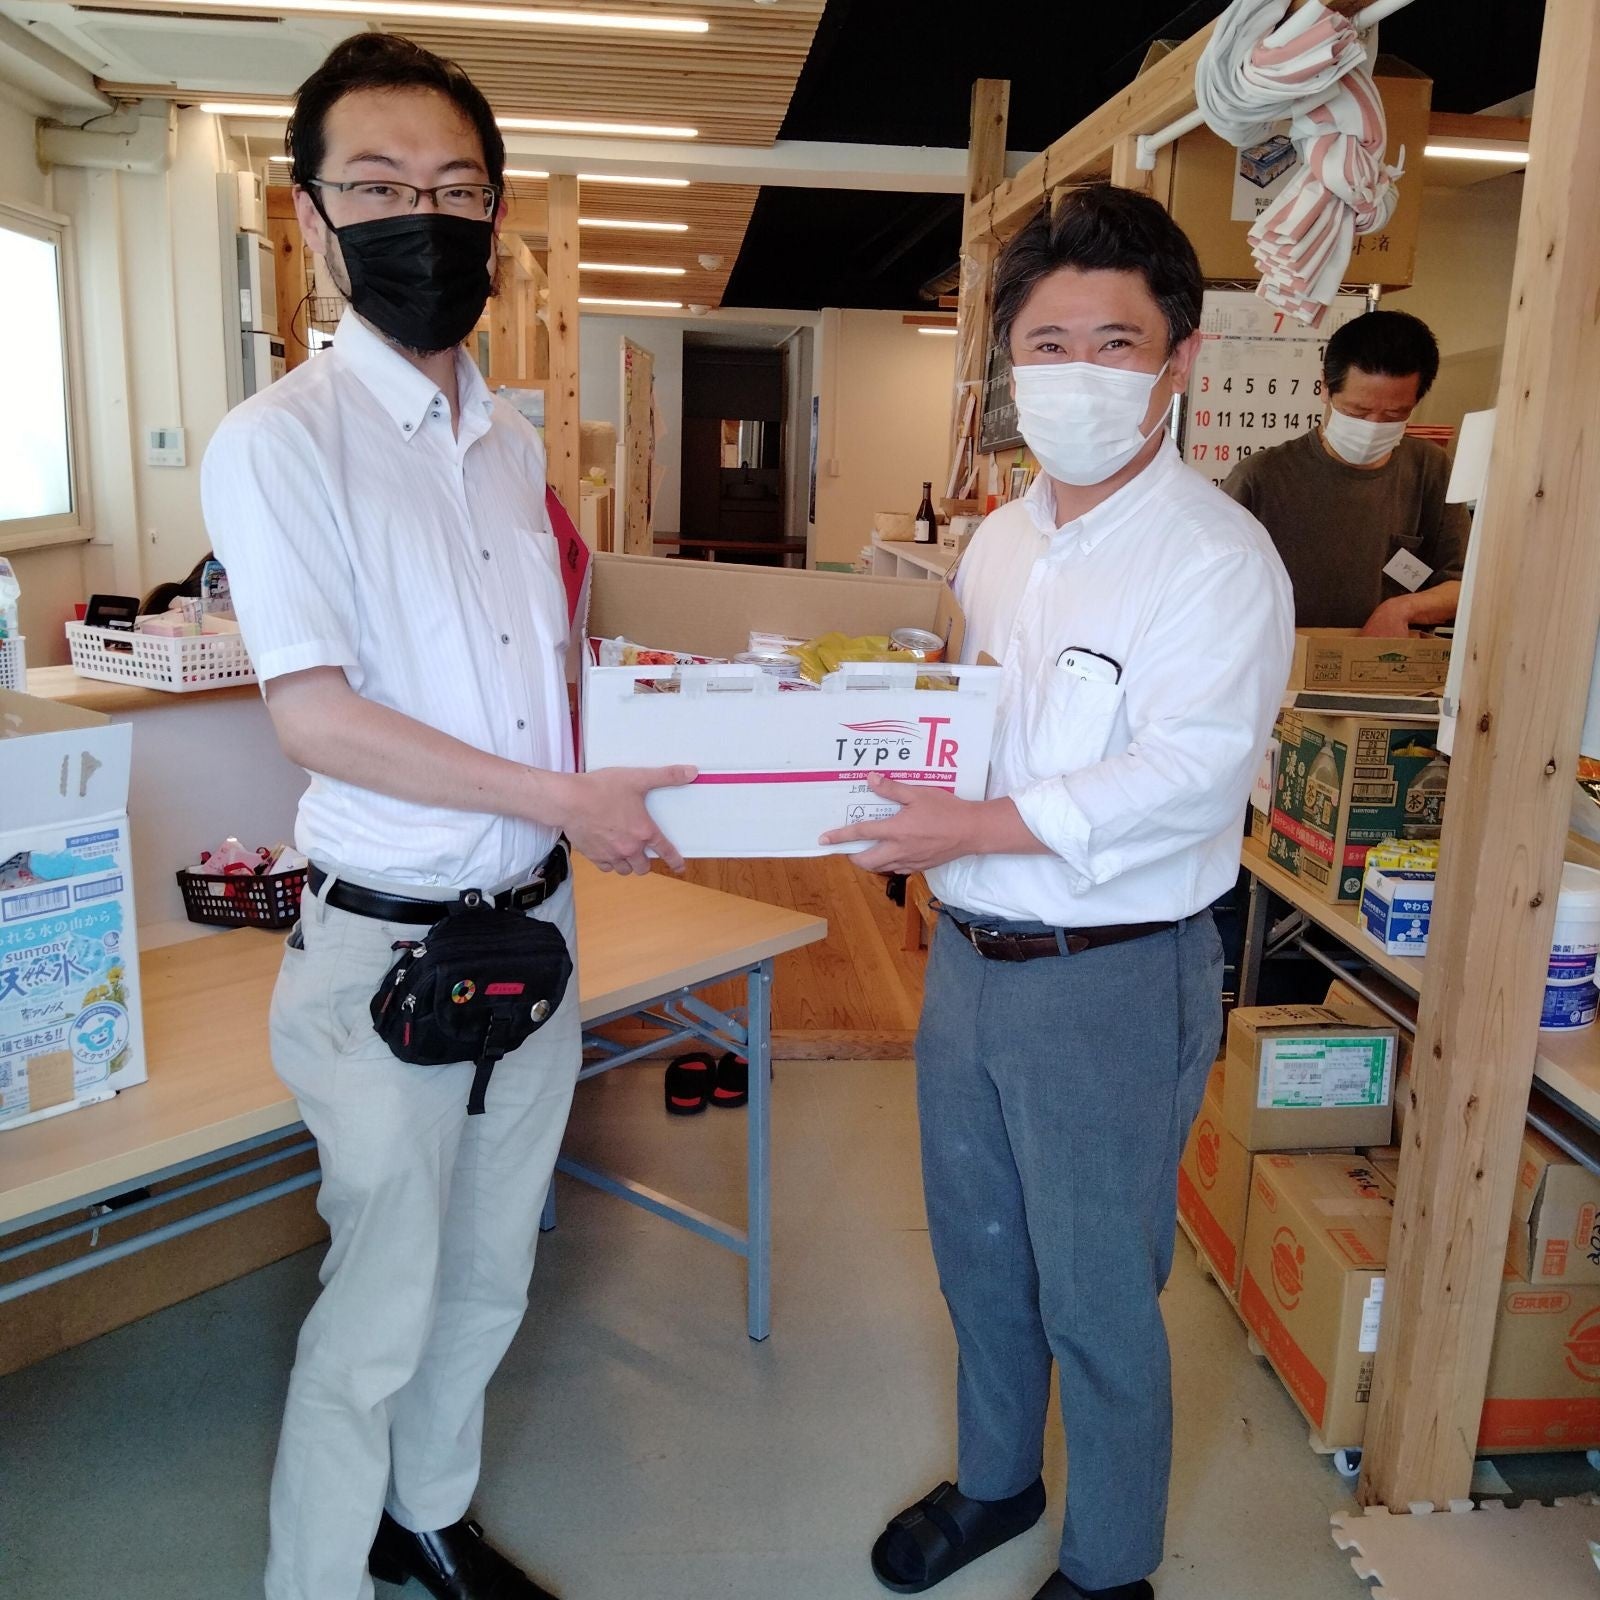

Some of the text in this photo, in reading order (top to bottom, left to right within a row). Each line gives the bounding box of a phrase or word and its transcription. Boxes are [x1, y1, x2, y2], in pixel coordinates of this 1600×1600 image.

[1273, 312, 1285, 333] 7
[1317, 346, 1325, 361] 1
[1201, 376, 1321, 395] 3 4 5 6 7 8
[1195, 411, 1322, 430] 10 11 12 13 14 15
[1193, 445, 1250, 461] 17 18 19
[836, 716, 959, 768] Type TR
[1408, 793, 1422, 810] 茶
[5, 940, 69, 963] SUNTORY
[0, 953, 90, 1001] 天然水
